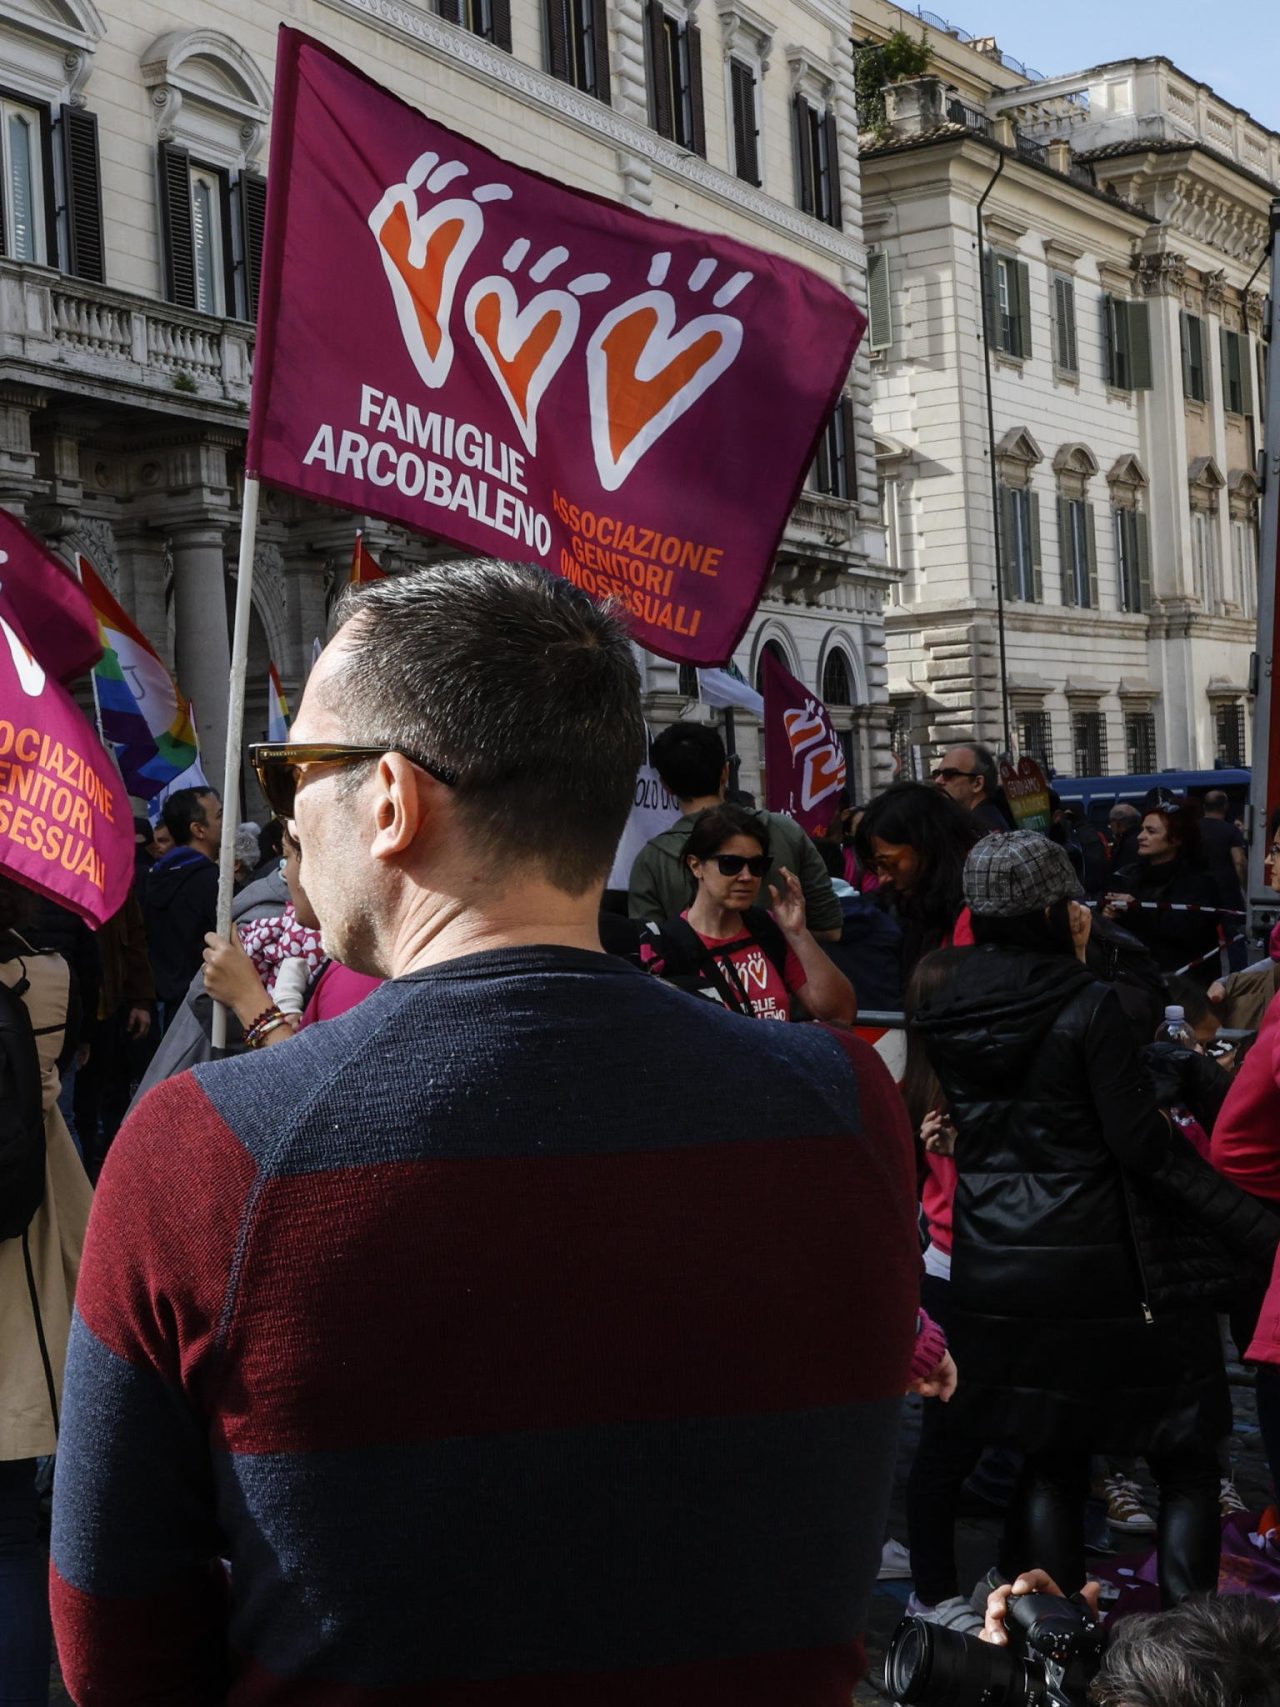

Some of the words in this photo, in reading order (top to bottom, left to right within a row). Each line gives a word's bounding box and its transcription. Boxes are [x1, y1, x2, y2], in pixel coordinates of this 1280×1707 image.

[359, 384, 528, 494] FAMIGLIE
[302, 424, 552, 556] ARCOBALENO
[553, 489, 724, 577] ASSOCIAZIONE
[572, 536, 675, 597] GENITORI
